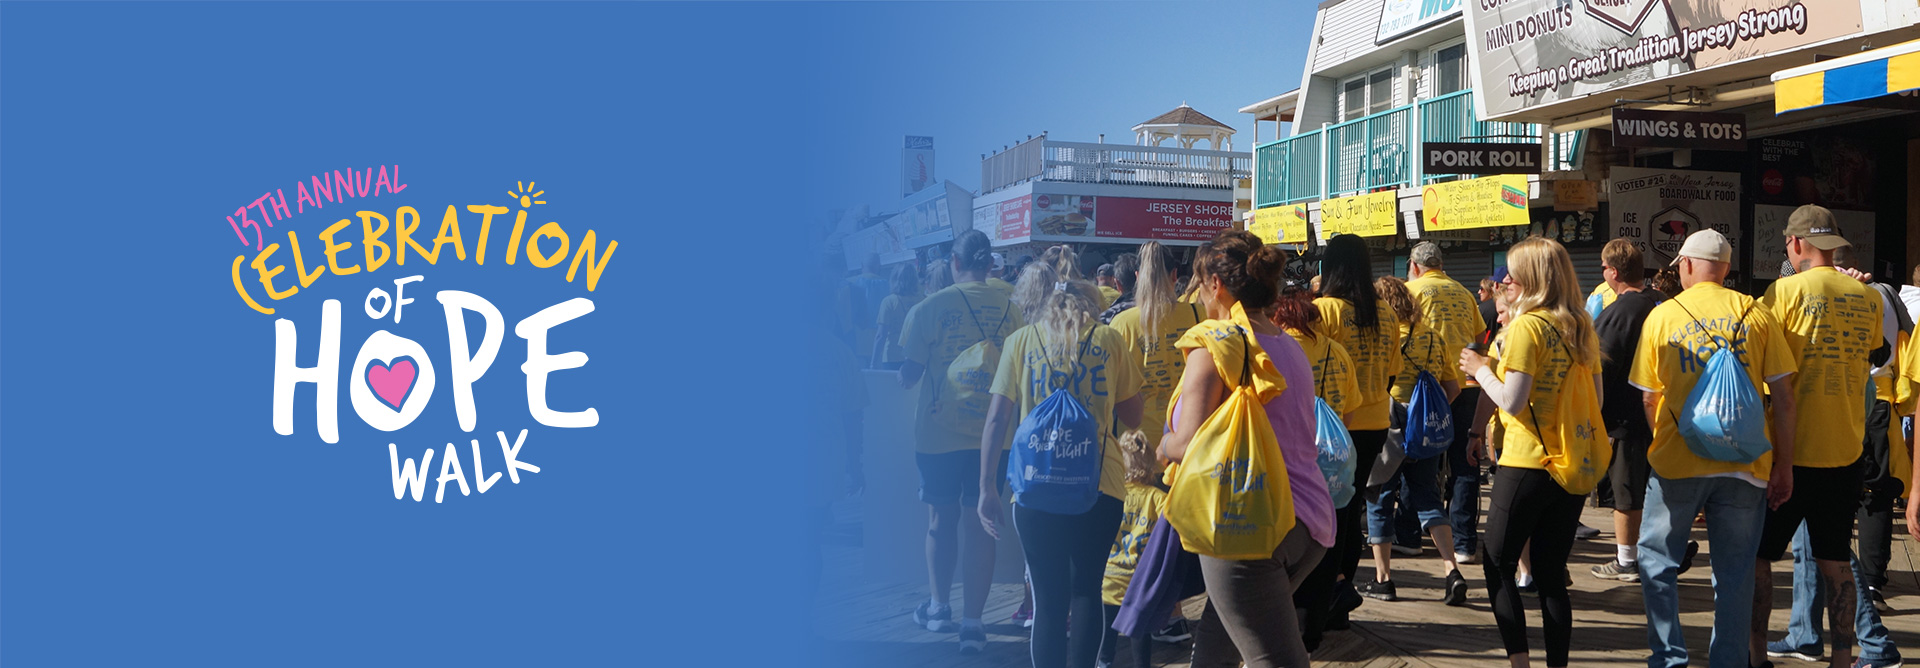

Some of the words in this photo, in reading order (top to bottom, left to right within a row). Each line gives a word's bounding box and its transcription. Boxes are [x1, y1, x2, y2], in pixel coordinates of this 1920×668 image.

[1485, 22, 1515, 52] MINI
[1516, 3, 1573, 42] DONUTS
[1508, 67, 1558, 97] Keeping
[1557, 65, 1568, 86] a
[1568, 50, 1608, 82] Great
[1608, 33, 1681, 71] Tradition
[1680, 20, 1737, 63] Jersey
[1737, 3, 1808, 42] Strong
[1616, 119, 1680, 139] WINGS
[1683, 120, 1697, 139] &
[1700, 122, 1742, 140] TOTS
[1762, 138, 1805, 149] CELEBRATE
[1762, 146, 1783, 155] WITH
[1784, 148, 1799, 156] THE
[1430, 150, 1484, 167] PORK
[1488, 150, 1535, 167] ROLL
[1762, 153, 1782, 162] BEST
[1617, 179, 1646, 191] VOTED
[1647, 176, 1665, 187] #24
[1678, 174, 1701, 187] New
[1703, 176, 1735, 189] Jersey
[1659, 188, 1712, 200] BOARDWALK
[1714, 190, 1736, 201] FOOD
[1146, 202, 1191, 214] JERSEY
[1194, 205, 1234, 216] SHORE
[1321, 203, 1335, 223] Sun
[1335, 200, 1343, 219] &
[1345, 199, 1362, 220] Fun
[1364, 195, 1395, 220] Jewelry
[1162, 215, 1182, 226] The
[1185, 216, 1234, 228] Breakfast
[1623, 213, 1637, 223] ICE
[1619, 227, 1641, 238] COLD
[1803, 302, 1830, 317] HOPE
[1668, 316, 1750, 348] CELEBRATION
[1696, 332, 1708, 344] OF
[1030, 361, 1108, 398] HOPE
[1043, 427, 1073, 442] HOPE
[1056, 437, 1092, 459] LIGHT
